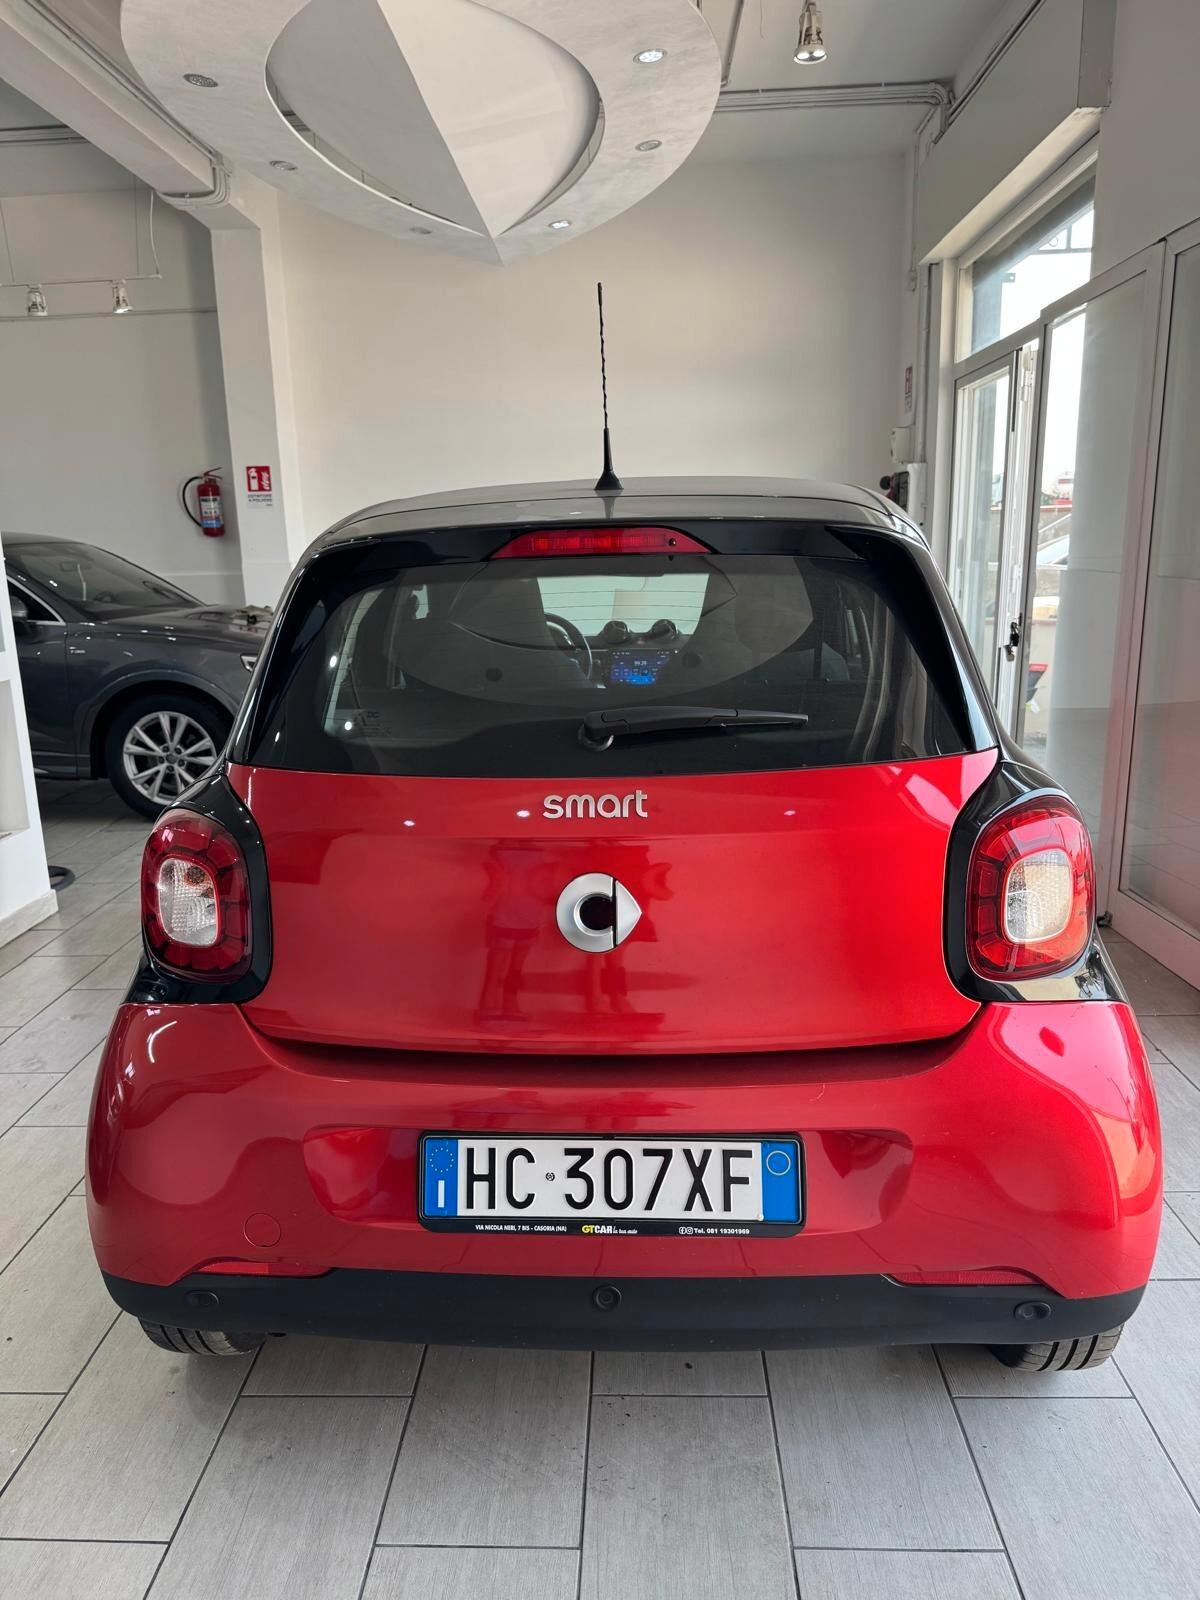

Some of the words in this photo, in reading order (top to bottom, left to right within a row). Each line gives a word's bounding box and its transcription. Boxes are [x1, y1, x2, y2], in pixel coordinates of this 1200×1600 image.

[543, 790, 648, 819] smart
[466, 1147, 536, 1210] HC
[563, 1147, 753, 1212] 307XF
